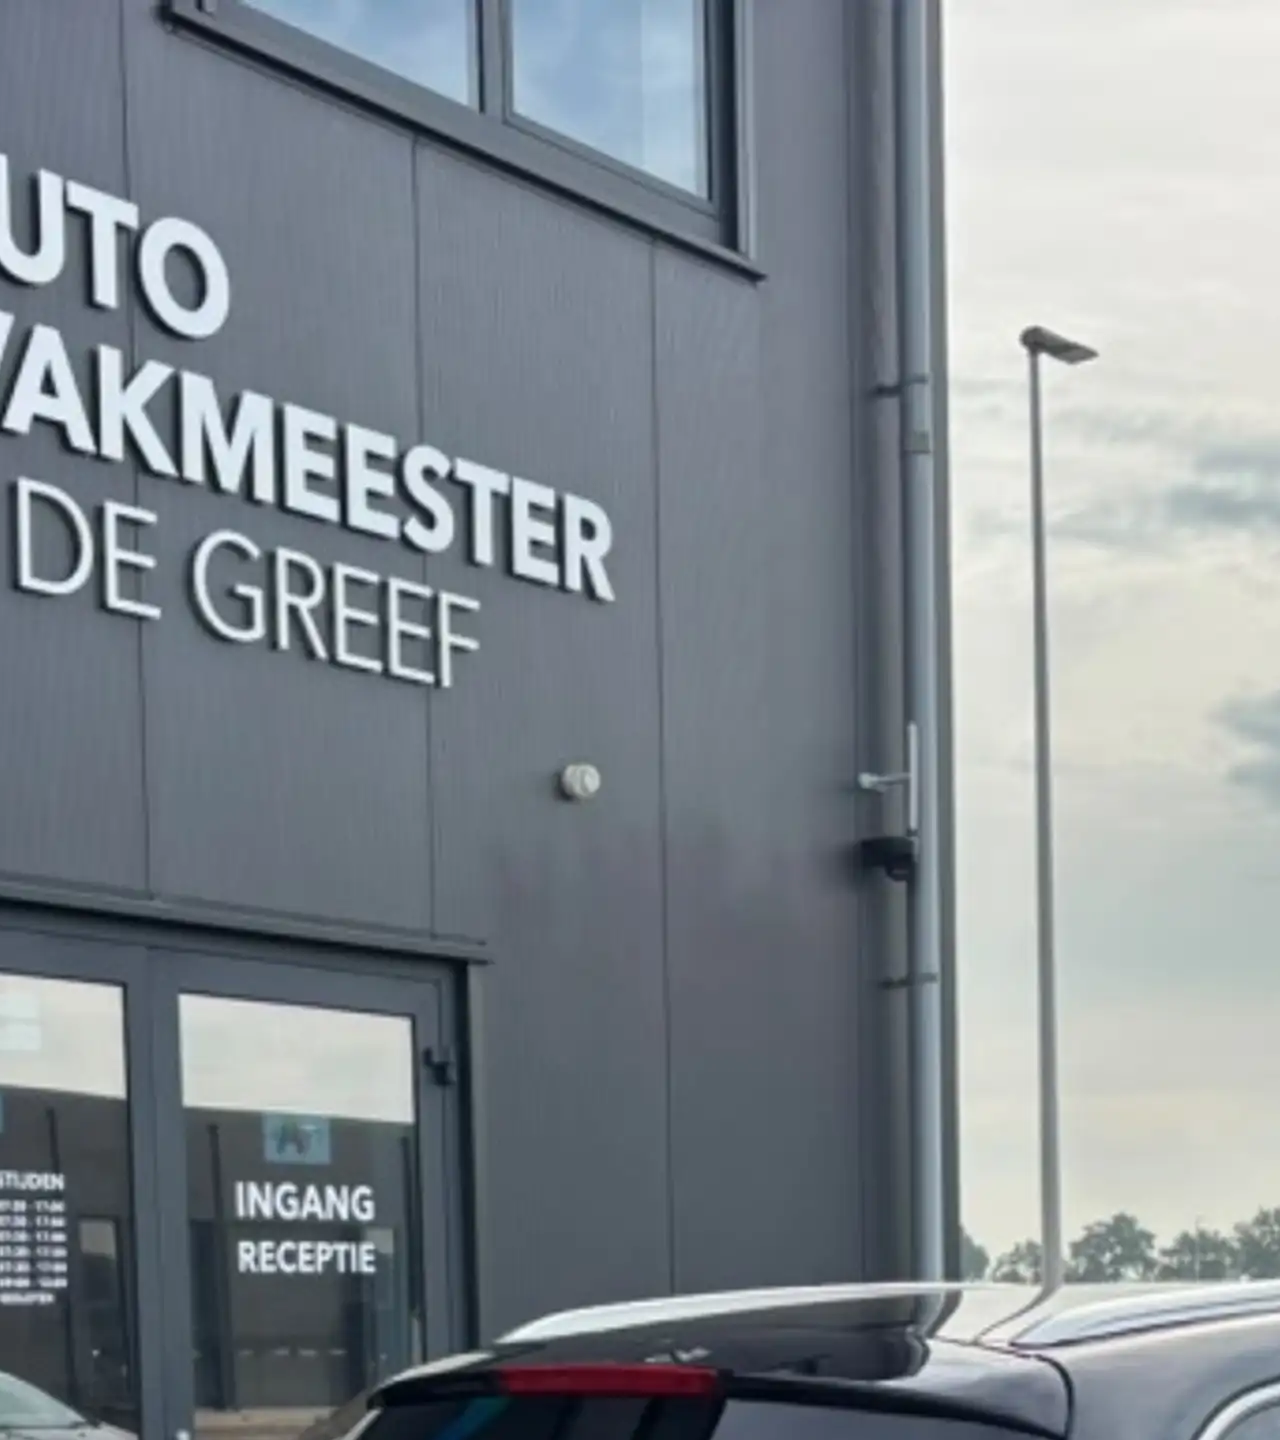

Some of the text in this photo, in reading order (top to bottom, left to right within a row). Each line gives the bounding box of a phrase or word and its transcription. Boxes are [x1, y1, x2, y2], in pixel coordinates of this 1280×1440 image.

[14, 474, 482, 690] DE GREEF
[234, 1180, 376, 1222] INGANG
[237, 1240, 377, 1274] RECEPTIE
